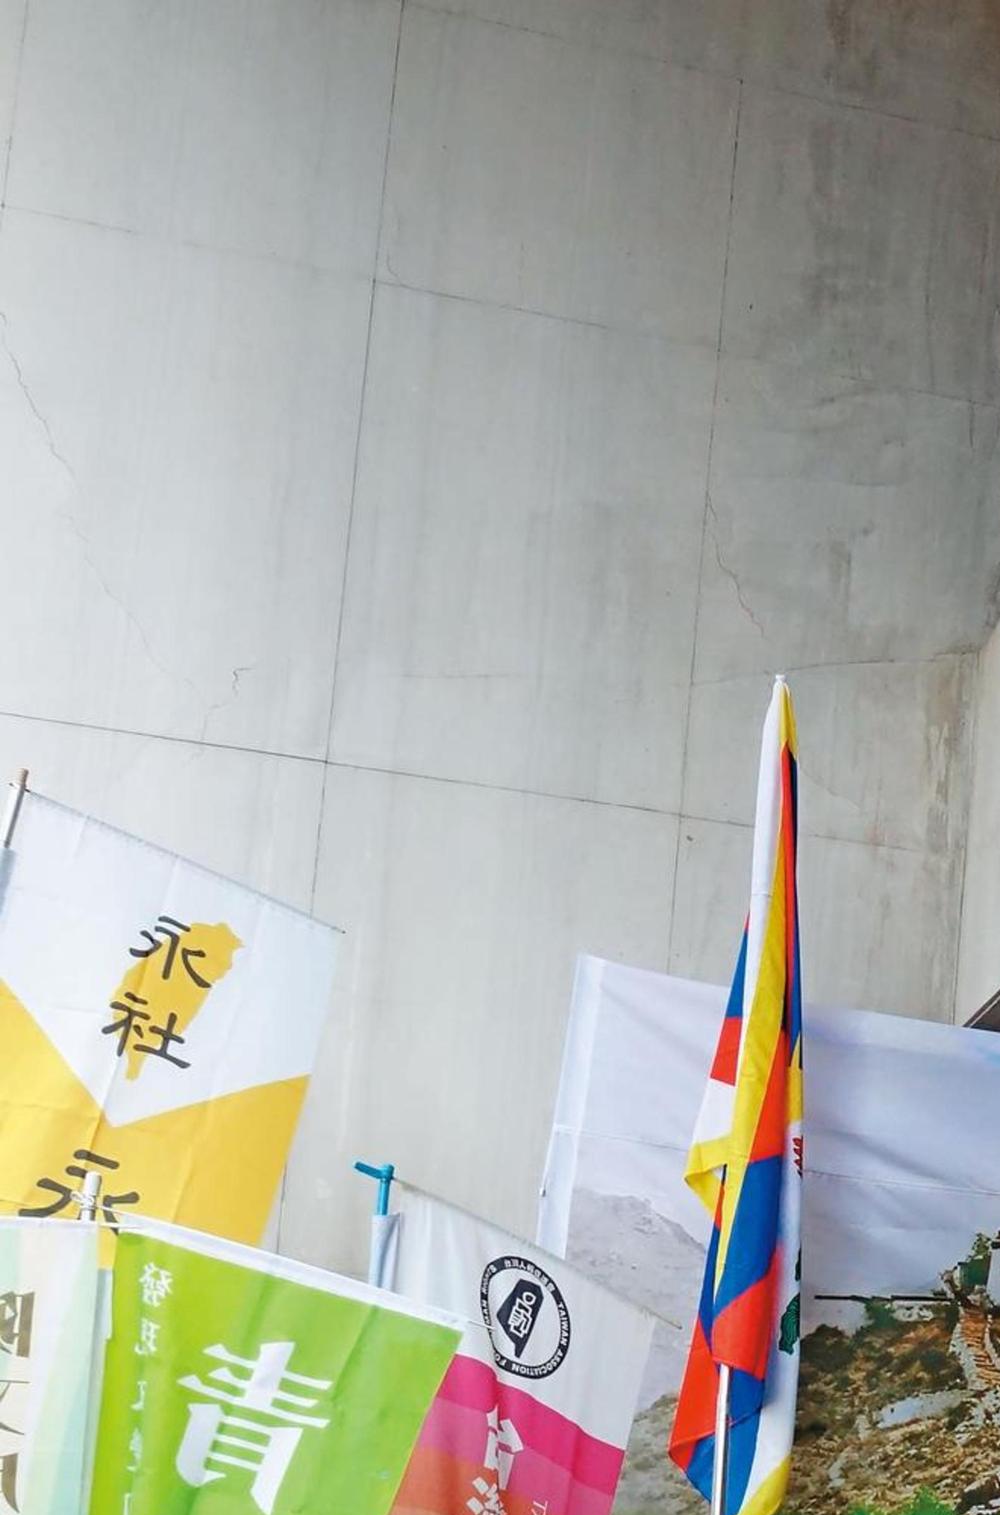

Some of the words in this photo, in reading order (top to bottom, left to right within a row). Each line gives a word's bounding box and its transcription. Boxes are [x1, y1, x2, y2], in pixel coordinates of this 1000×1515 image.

[101, 916, 211, 1069] 永社
[558, 1301, 569, 1346] TAIWAN
[511, 1349, 563, 1376] ASSOCIATION
